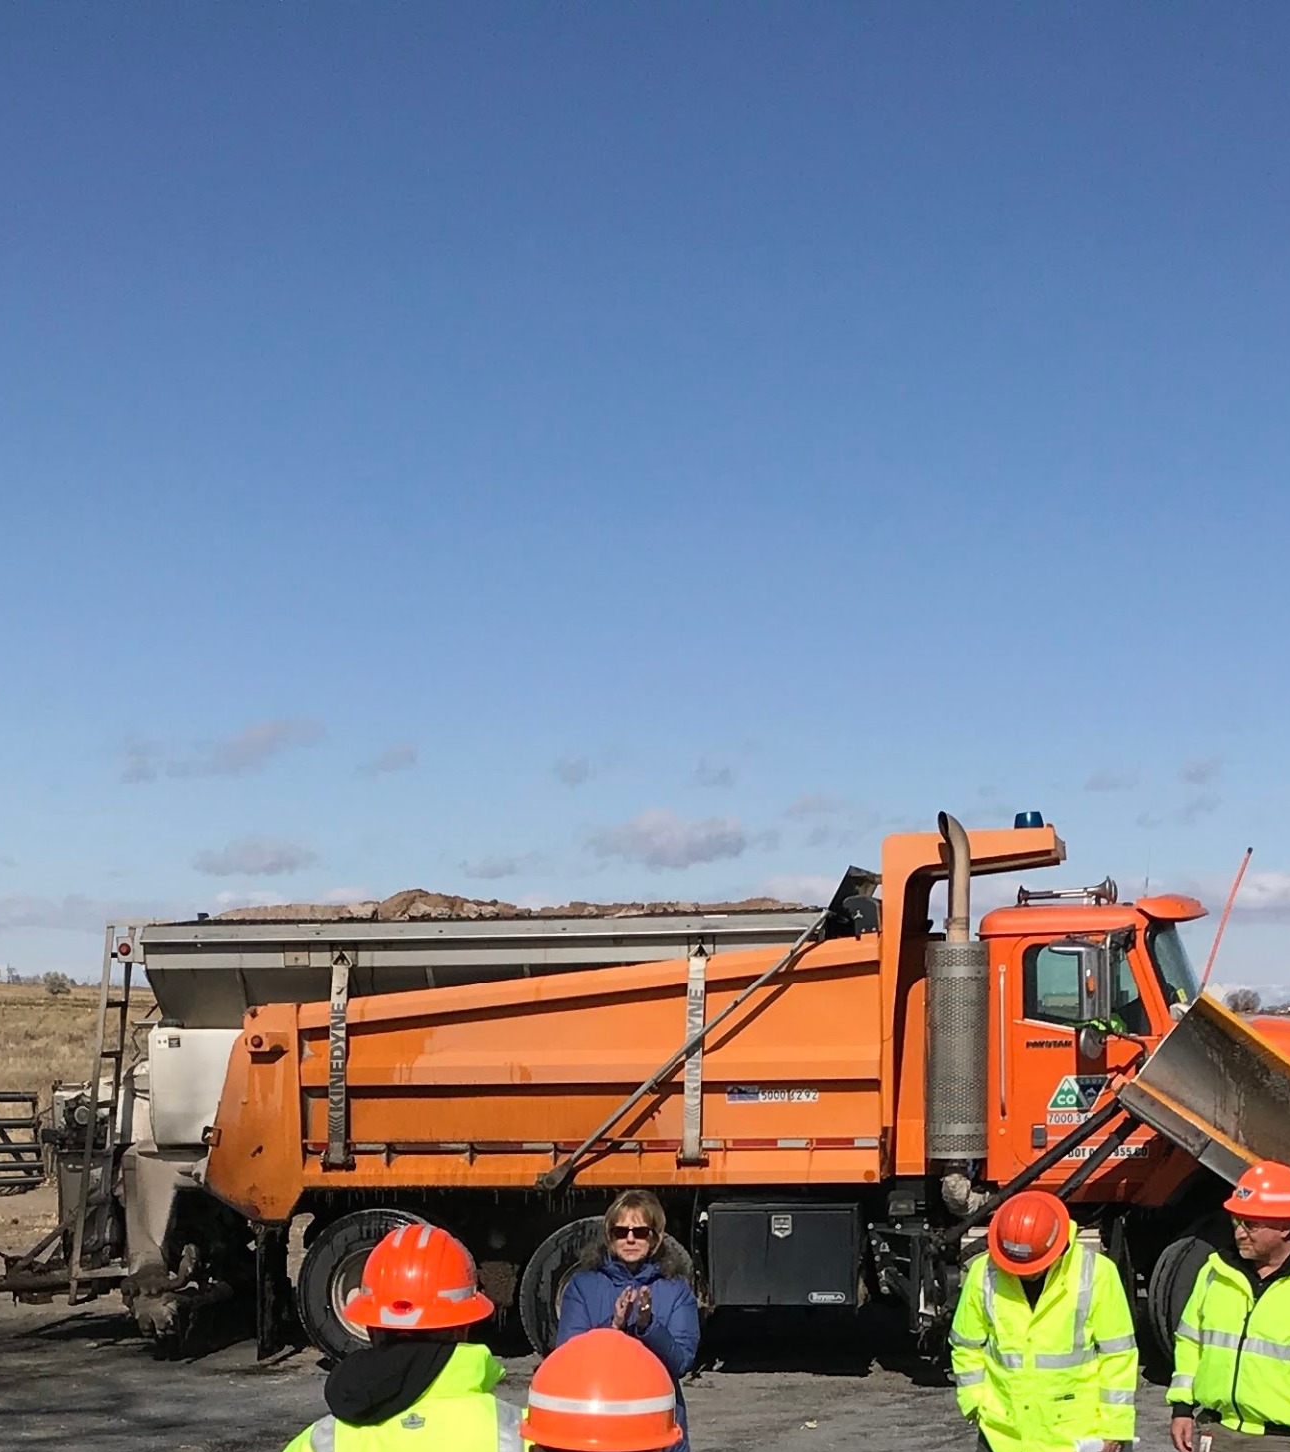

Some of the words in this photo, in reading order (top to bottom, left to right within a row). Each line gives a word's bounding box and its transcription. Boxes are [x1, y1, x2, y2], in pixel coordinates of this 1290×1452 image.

[684, 988, 704, 1100] KINYNE
[329, 1002, 346, 1113] KINEDYNE
[761, 1090, 786, 1100] 5000
[1056, 1094, 1077, 1105] CO
[1048, 1114, 1073, 1123] 7000
